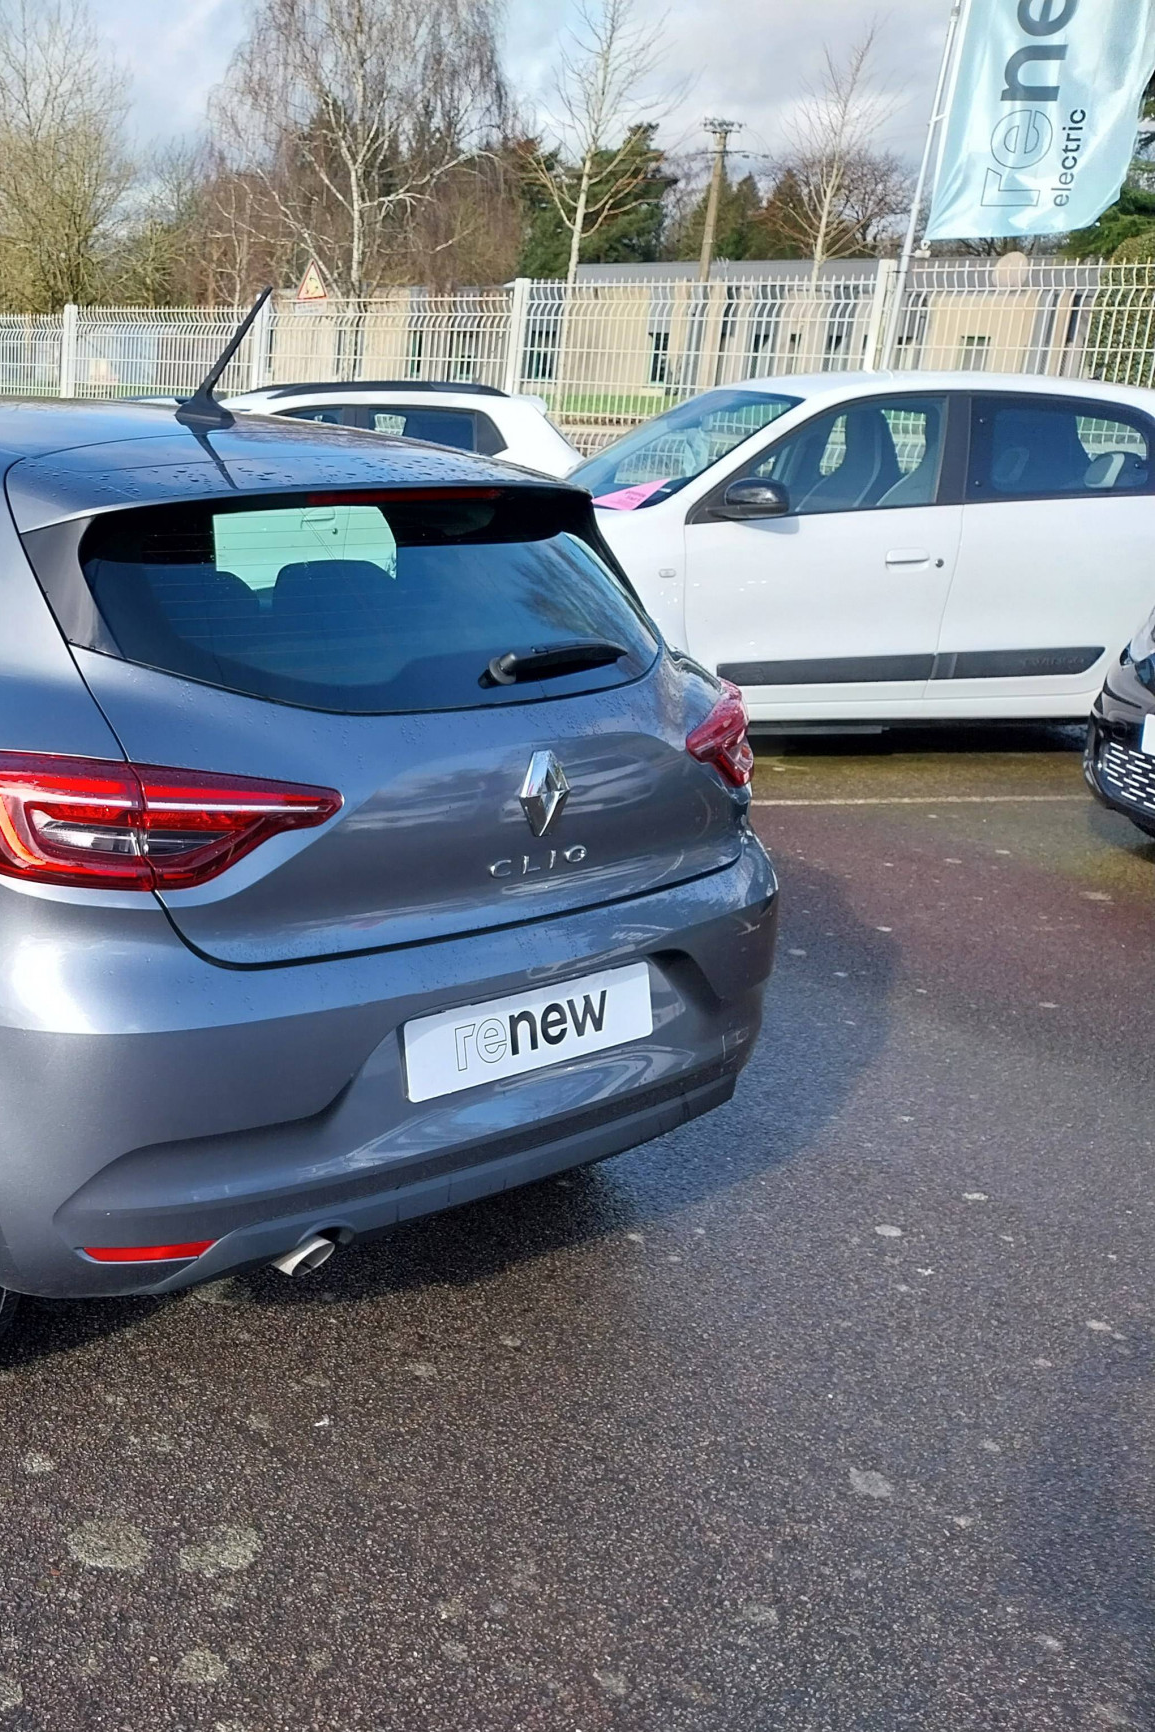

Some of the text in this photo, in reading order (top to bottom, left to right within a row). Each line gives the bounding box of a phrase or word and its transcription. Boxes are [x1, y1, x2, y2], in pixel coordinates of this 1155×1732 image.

[1050, 108, 1087, 207] electric
[489, 845, 587, 878] CLIO
[453, 989, 608, 1072] renew
